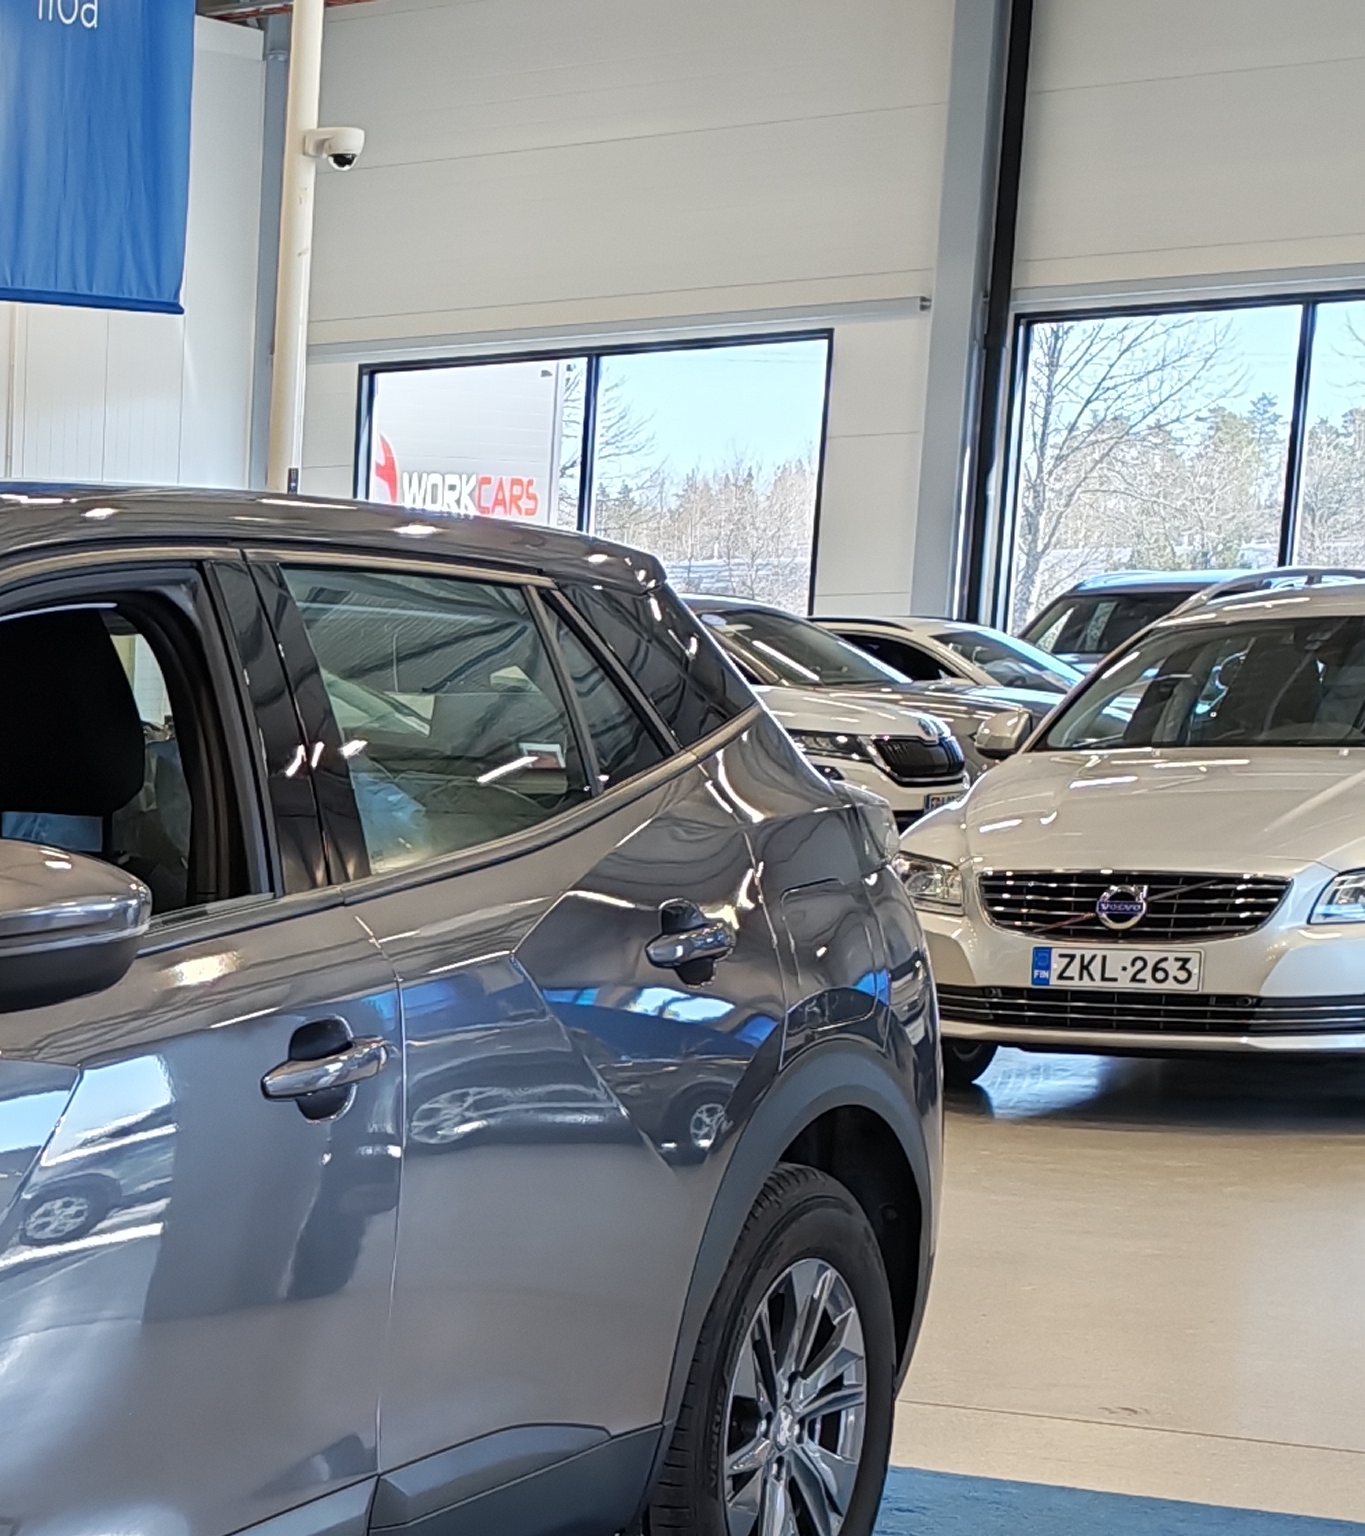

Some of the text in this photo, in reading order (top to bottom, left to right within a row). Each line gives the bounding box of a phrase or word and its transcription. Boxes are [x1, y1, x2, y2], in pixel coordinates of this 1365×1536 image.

[402, 472, 539, 517] WORKCARS
[1099, 901, 1144, 912] VOLVO
[1033, 953, 1193, 985] FIN ZKL-263
